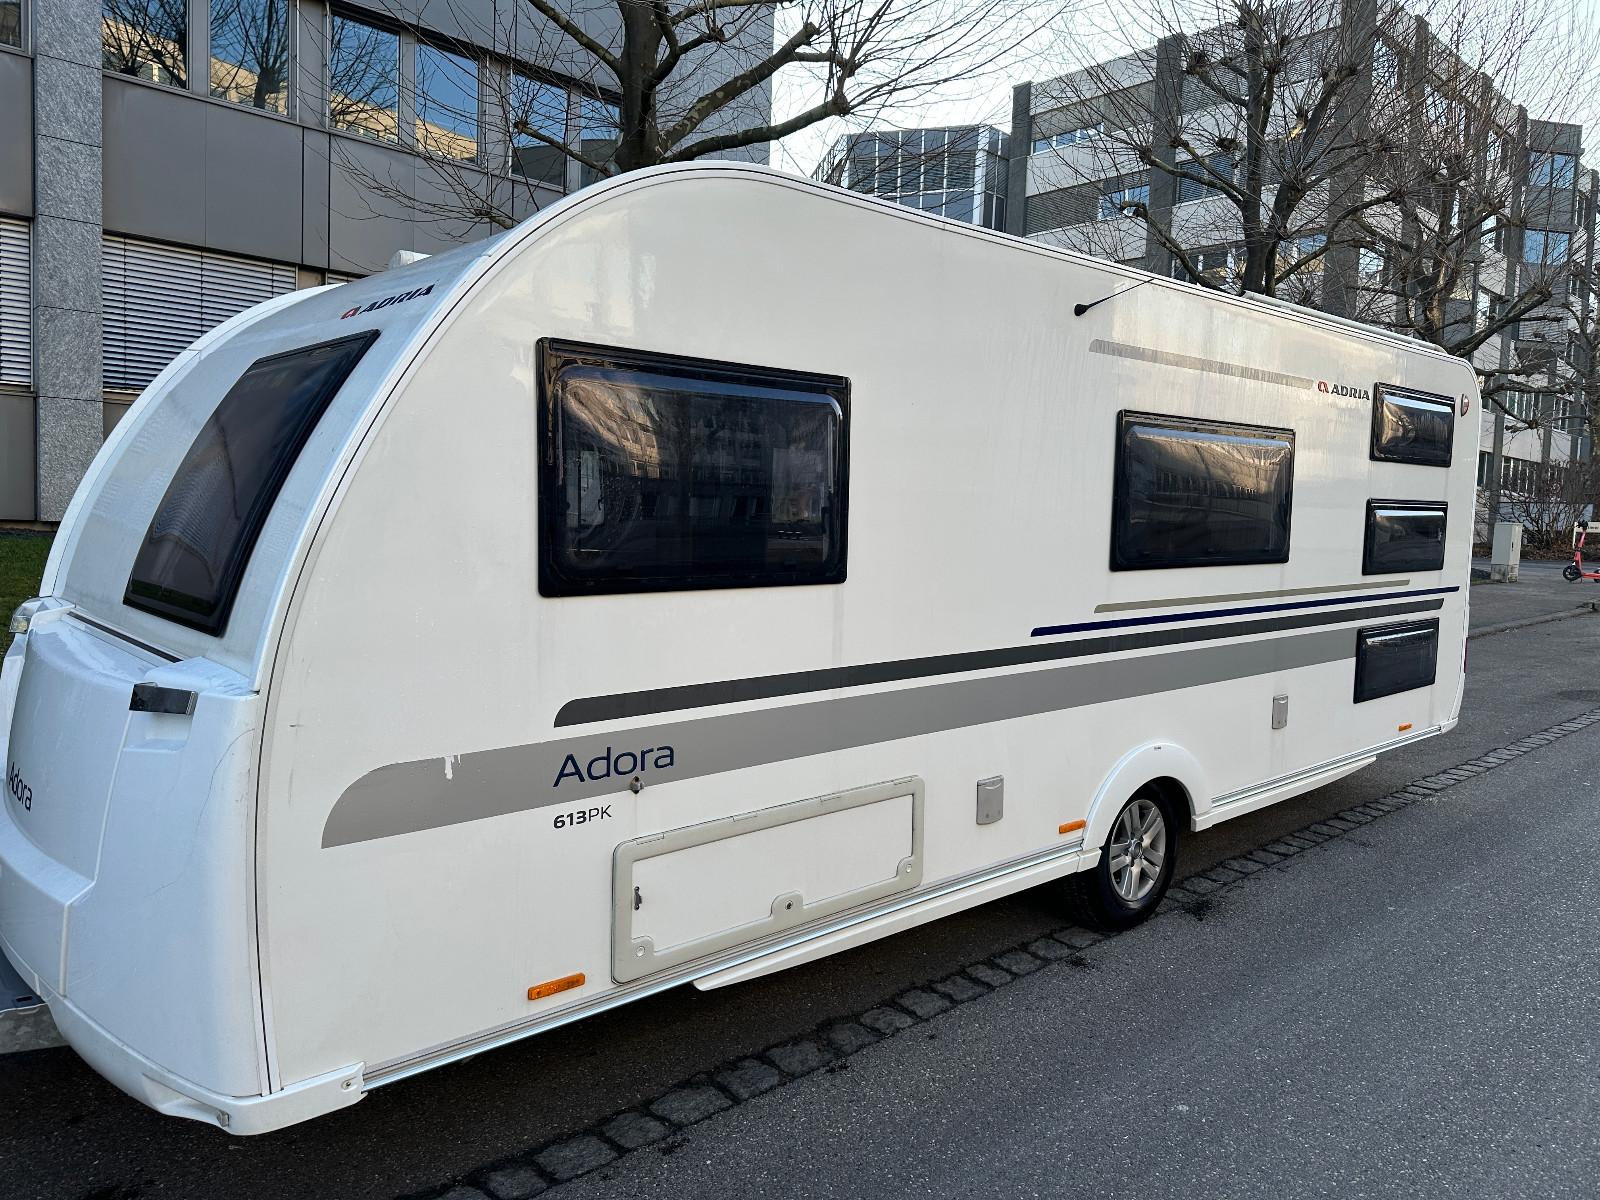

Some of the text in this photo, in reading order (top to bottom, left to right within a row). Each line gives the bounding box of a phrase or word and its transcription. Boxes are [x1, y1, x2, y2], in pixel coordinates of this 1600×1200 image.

[358, 283, 436, 315] ADRIA
[1331, 383, 1370, 401] ADRIA
[553, 746, 674, 787] Adora
[9, 761, 32, 812] Adora
[553, 804, 612, 829] 613PK
